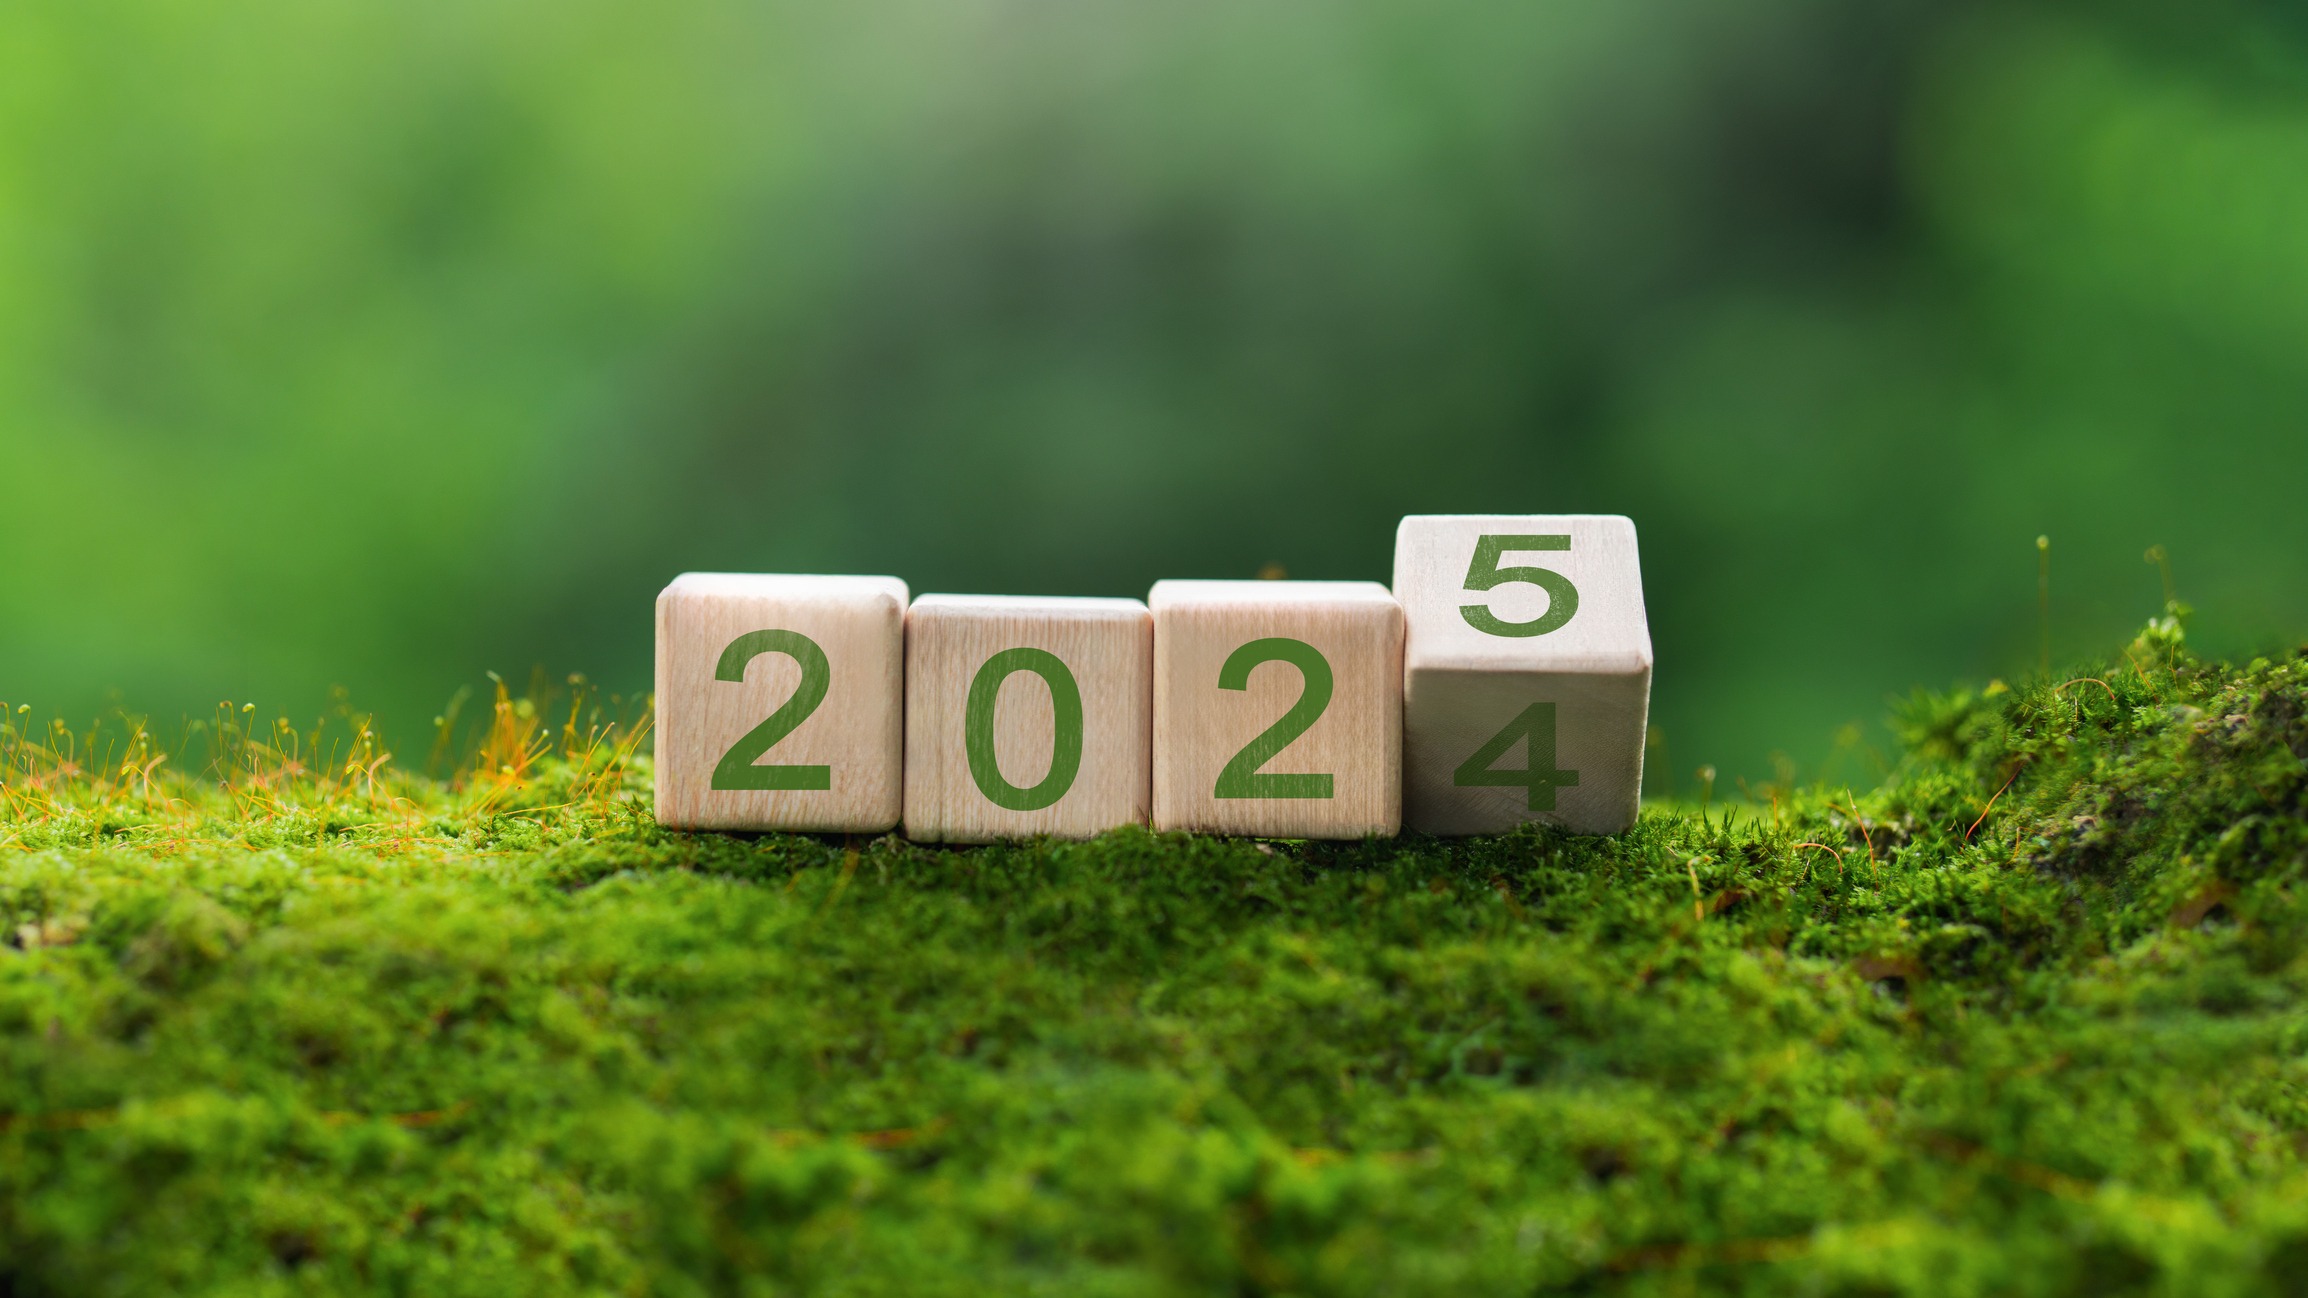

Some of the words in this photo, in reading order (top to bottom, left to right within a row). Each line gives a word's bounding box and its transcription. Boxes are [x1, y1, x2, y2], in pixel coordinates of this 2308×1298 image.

[1459, 534, 1579, 638] 5
[711, 629, 831, 791] 2
[965, 647, 1083, 811] 0
[1214, 637, 1335, 799] 2
[1453, 702, 1580, 812] 4
